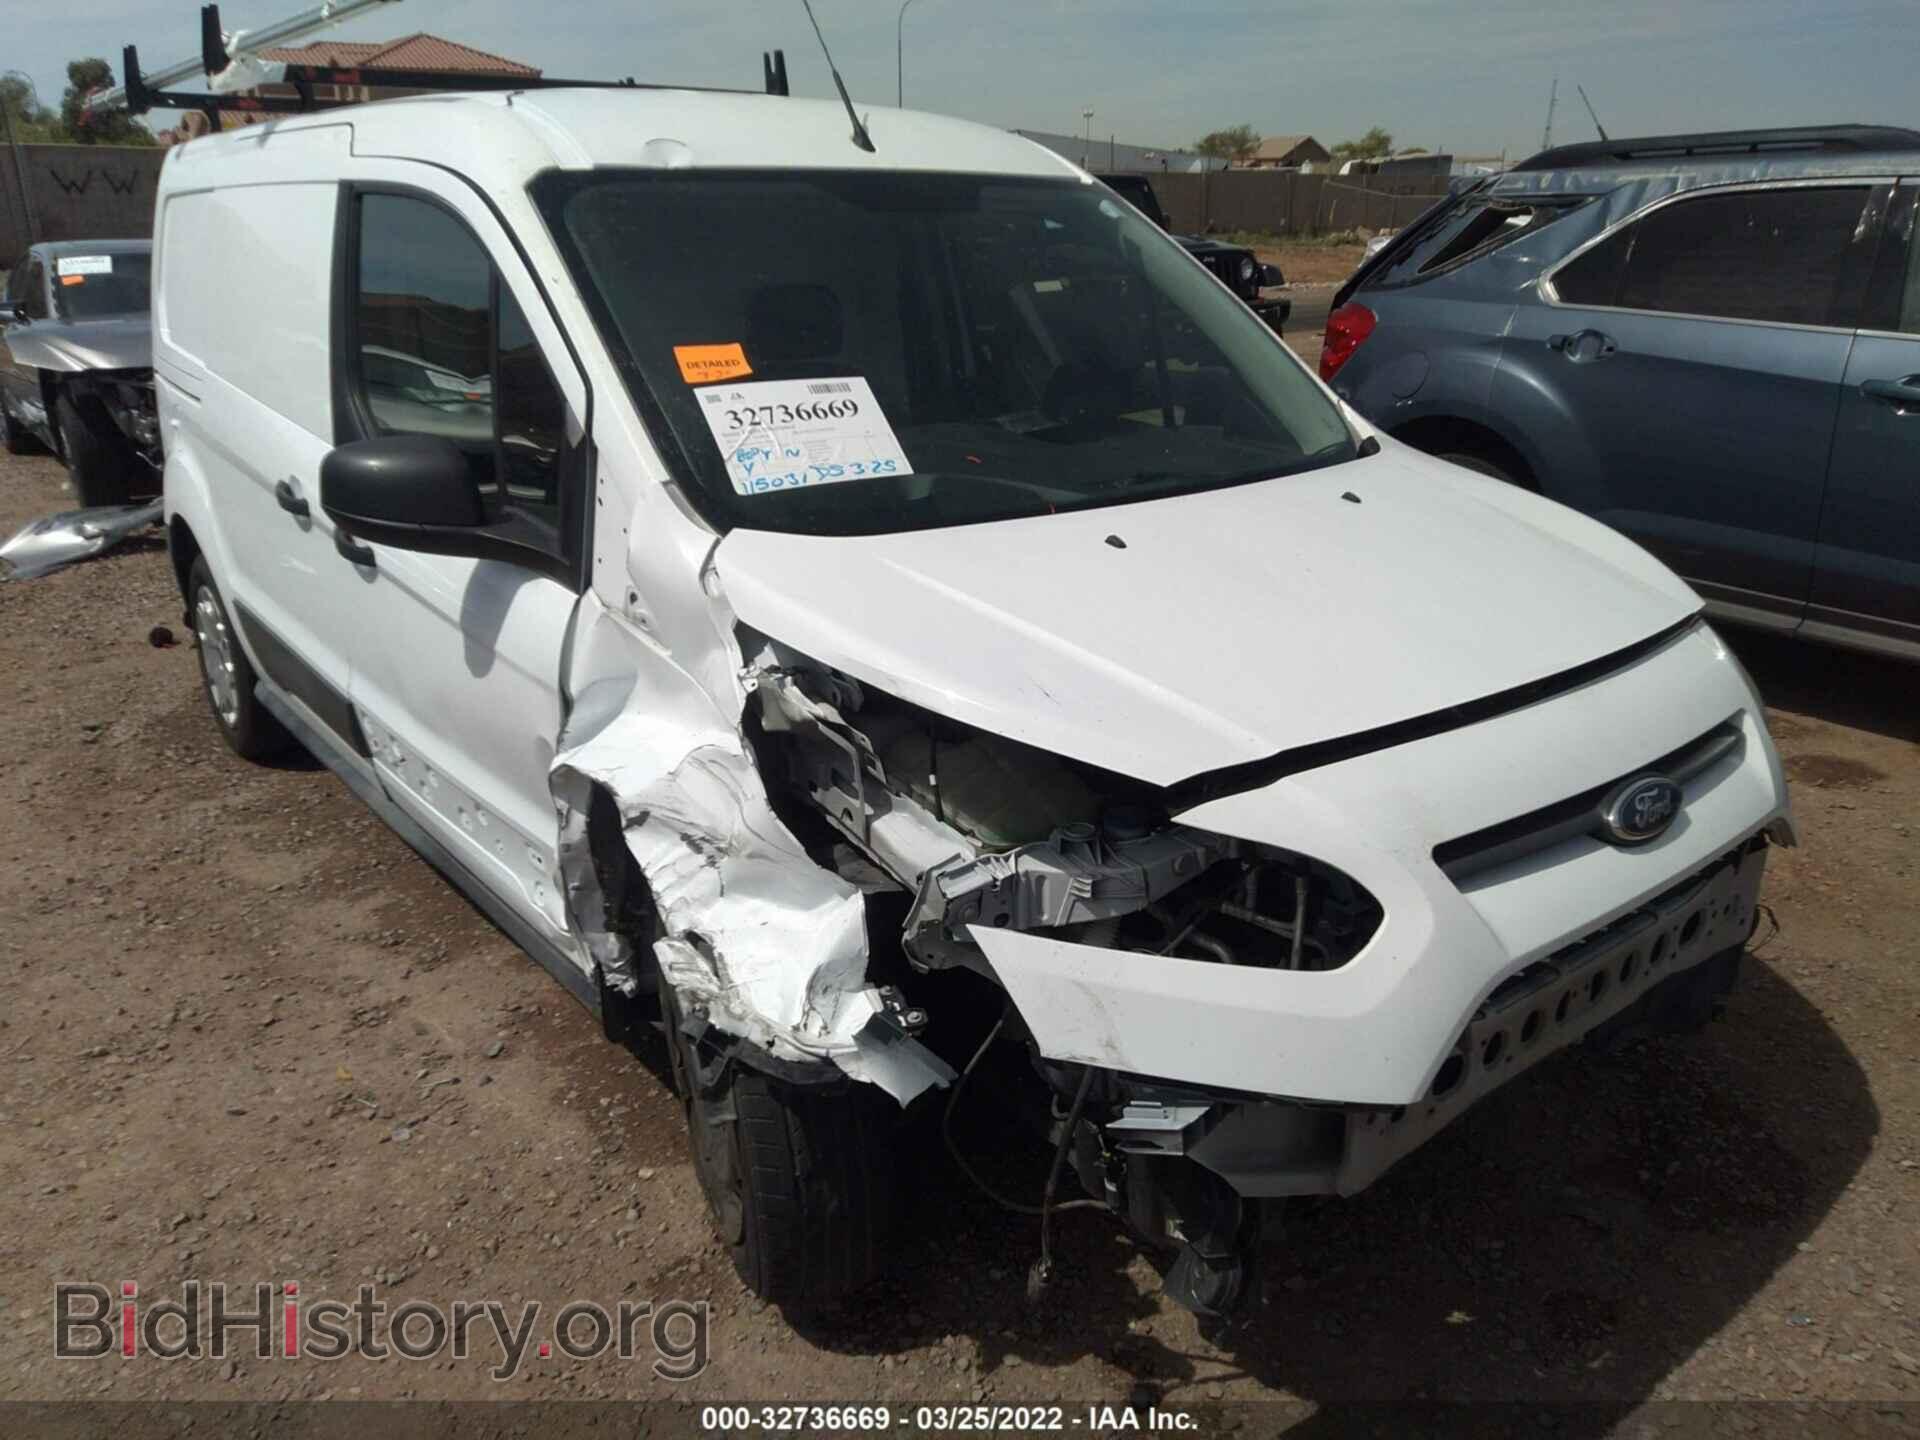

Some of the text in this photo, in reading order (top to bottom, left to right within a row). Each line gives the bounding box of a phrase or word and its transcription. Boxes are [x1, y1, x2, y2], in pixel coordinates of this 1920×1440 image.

[686, 358, 741, 370] DETAILED
[727, 399, 858, 430] 32736669
[1633, 787, 1671, 829] Ford
